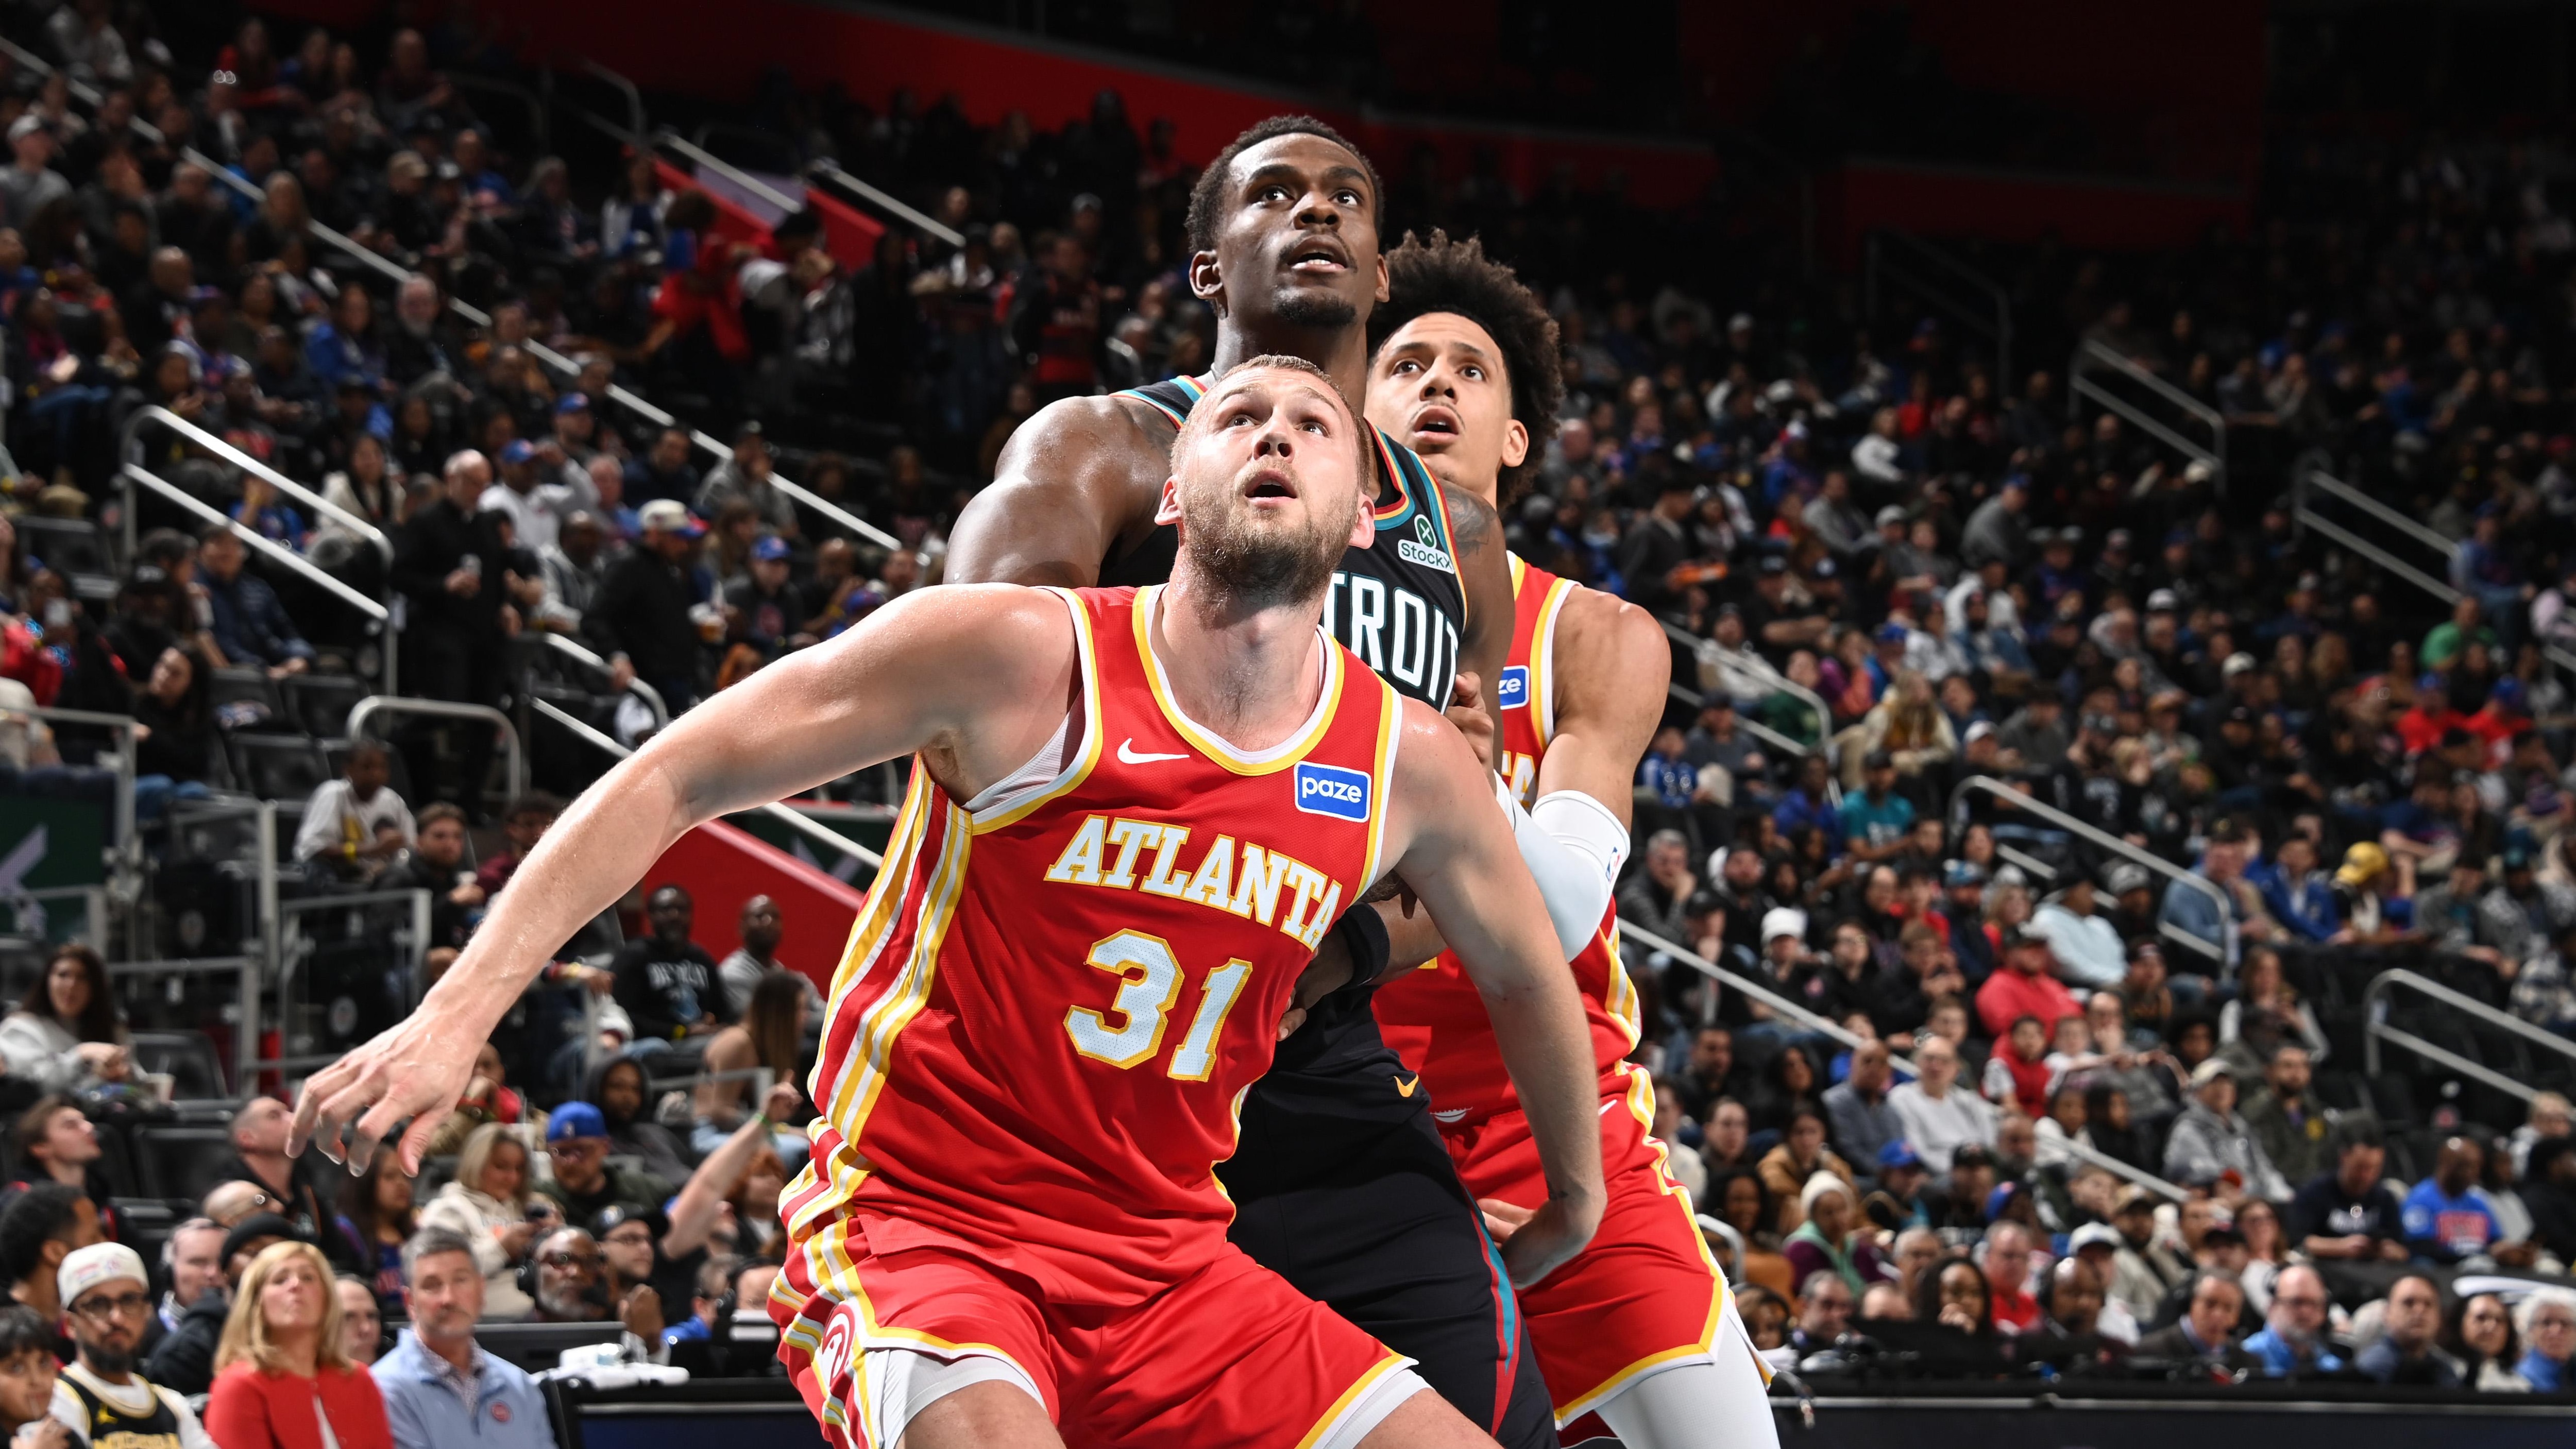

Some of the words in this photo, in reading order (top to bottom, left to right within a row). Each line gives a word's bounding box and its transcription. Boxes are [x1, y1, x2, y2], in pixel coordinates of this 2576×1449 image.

[1401, 542, 1453, 570] StockX
[1322, 570, 1459, 715] TROIT
[1498, 677, 1522, 694] ze
[1302, 776, 1362, 803] paze
[1043, 814, 1343, 952] ATLANTA
[1063, 928, 1253, 1083] 31
